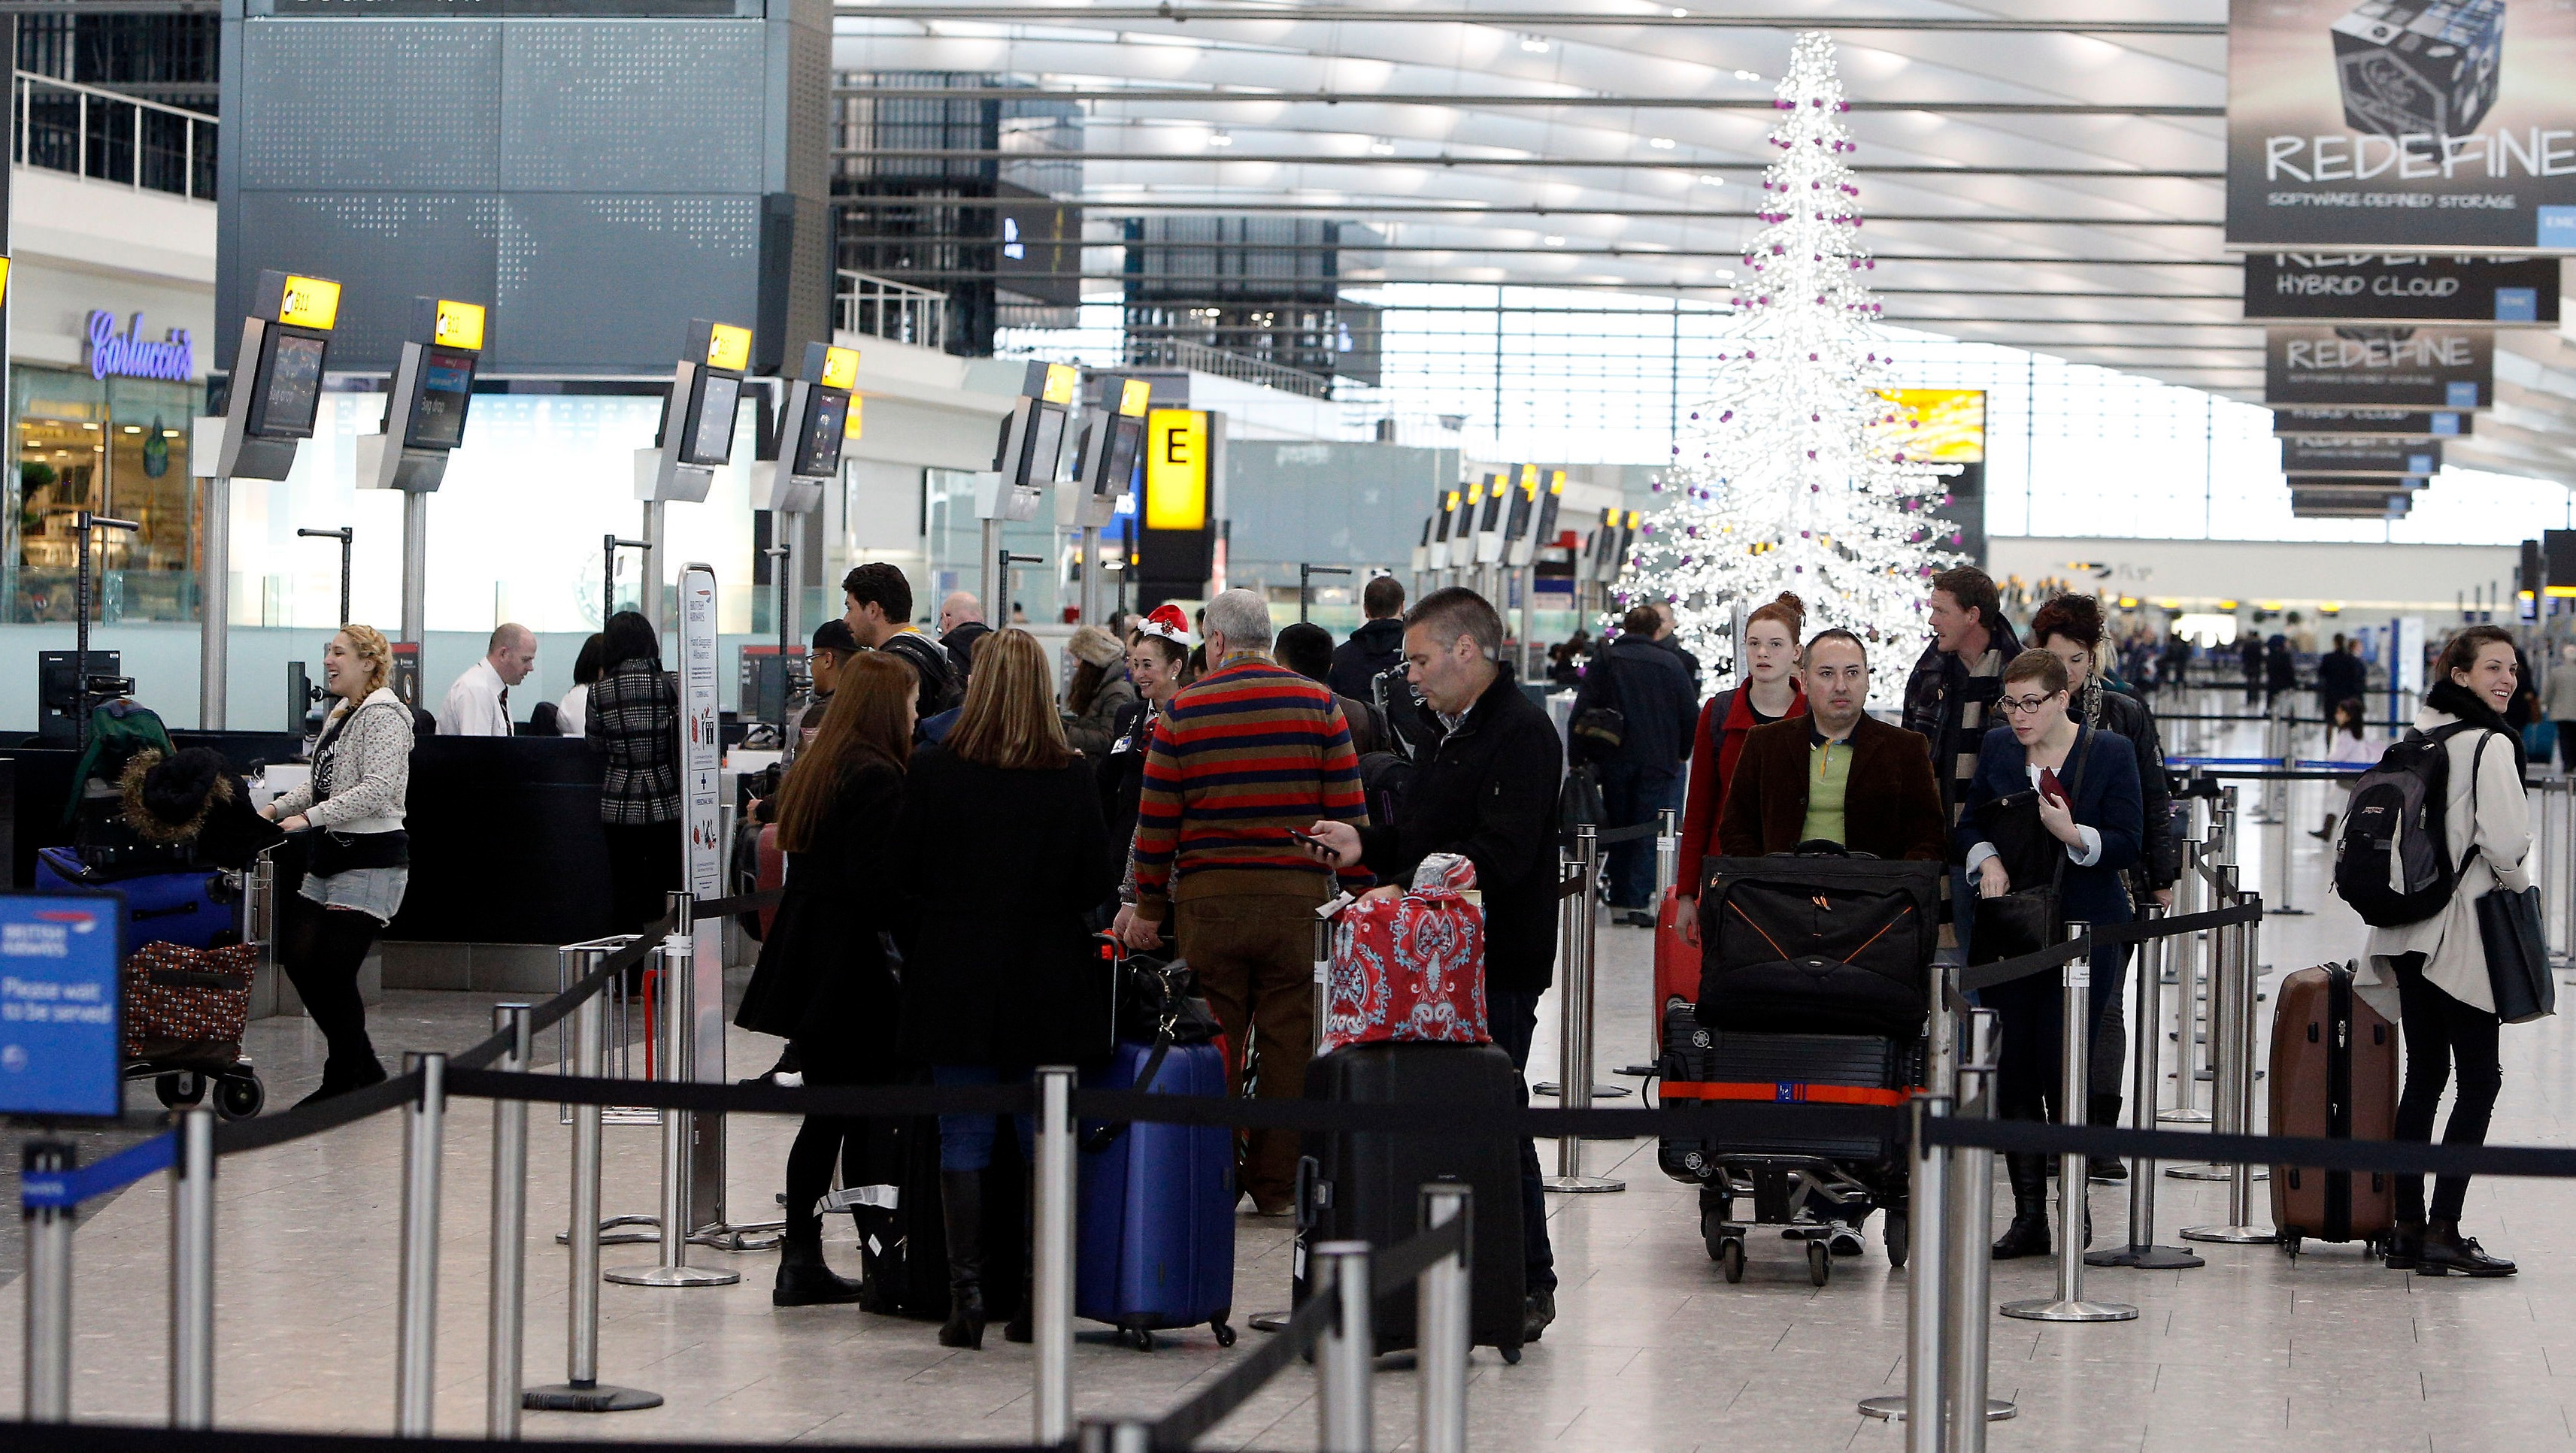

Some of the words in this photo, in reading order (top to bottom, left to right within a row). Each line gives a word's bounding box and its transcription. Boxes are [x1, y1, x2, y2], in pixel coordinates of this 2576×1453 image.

[2265, 126, 2575, 183] REDEFINE
[2436, 194, 2517, 209] STORAGE
[294, 292, 309, 311] B11
[2276, 274, 2365, 295] HYBRID
[2371, 276, 2460, 297] CLOUD
[89, 310, 193, 381] Carluccio's
[2287, 336, 2474, 369] REDEFINE
[1168, 428, 1188, 463] E
